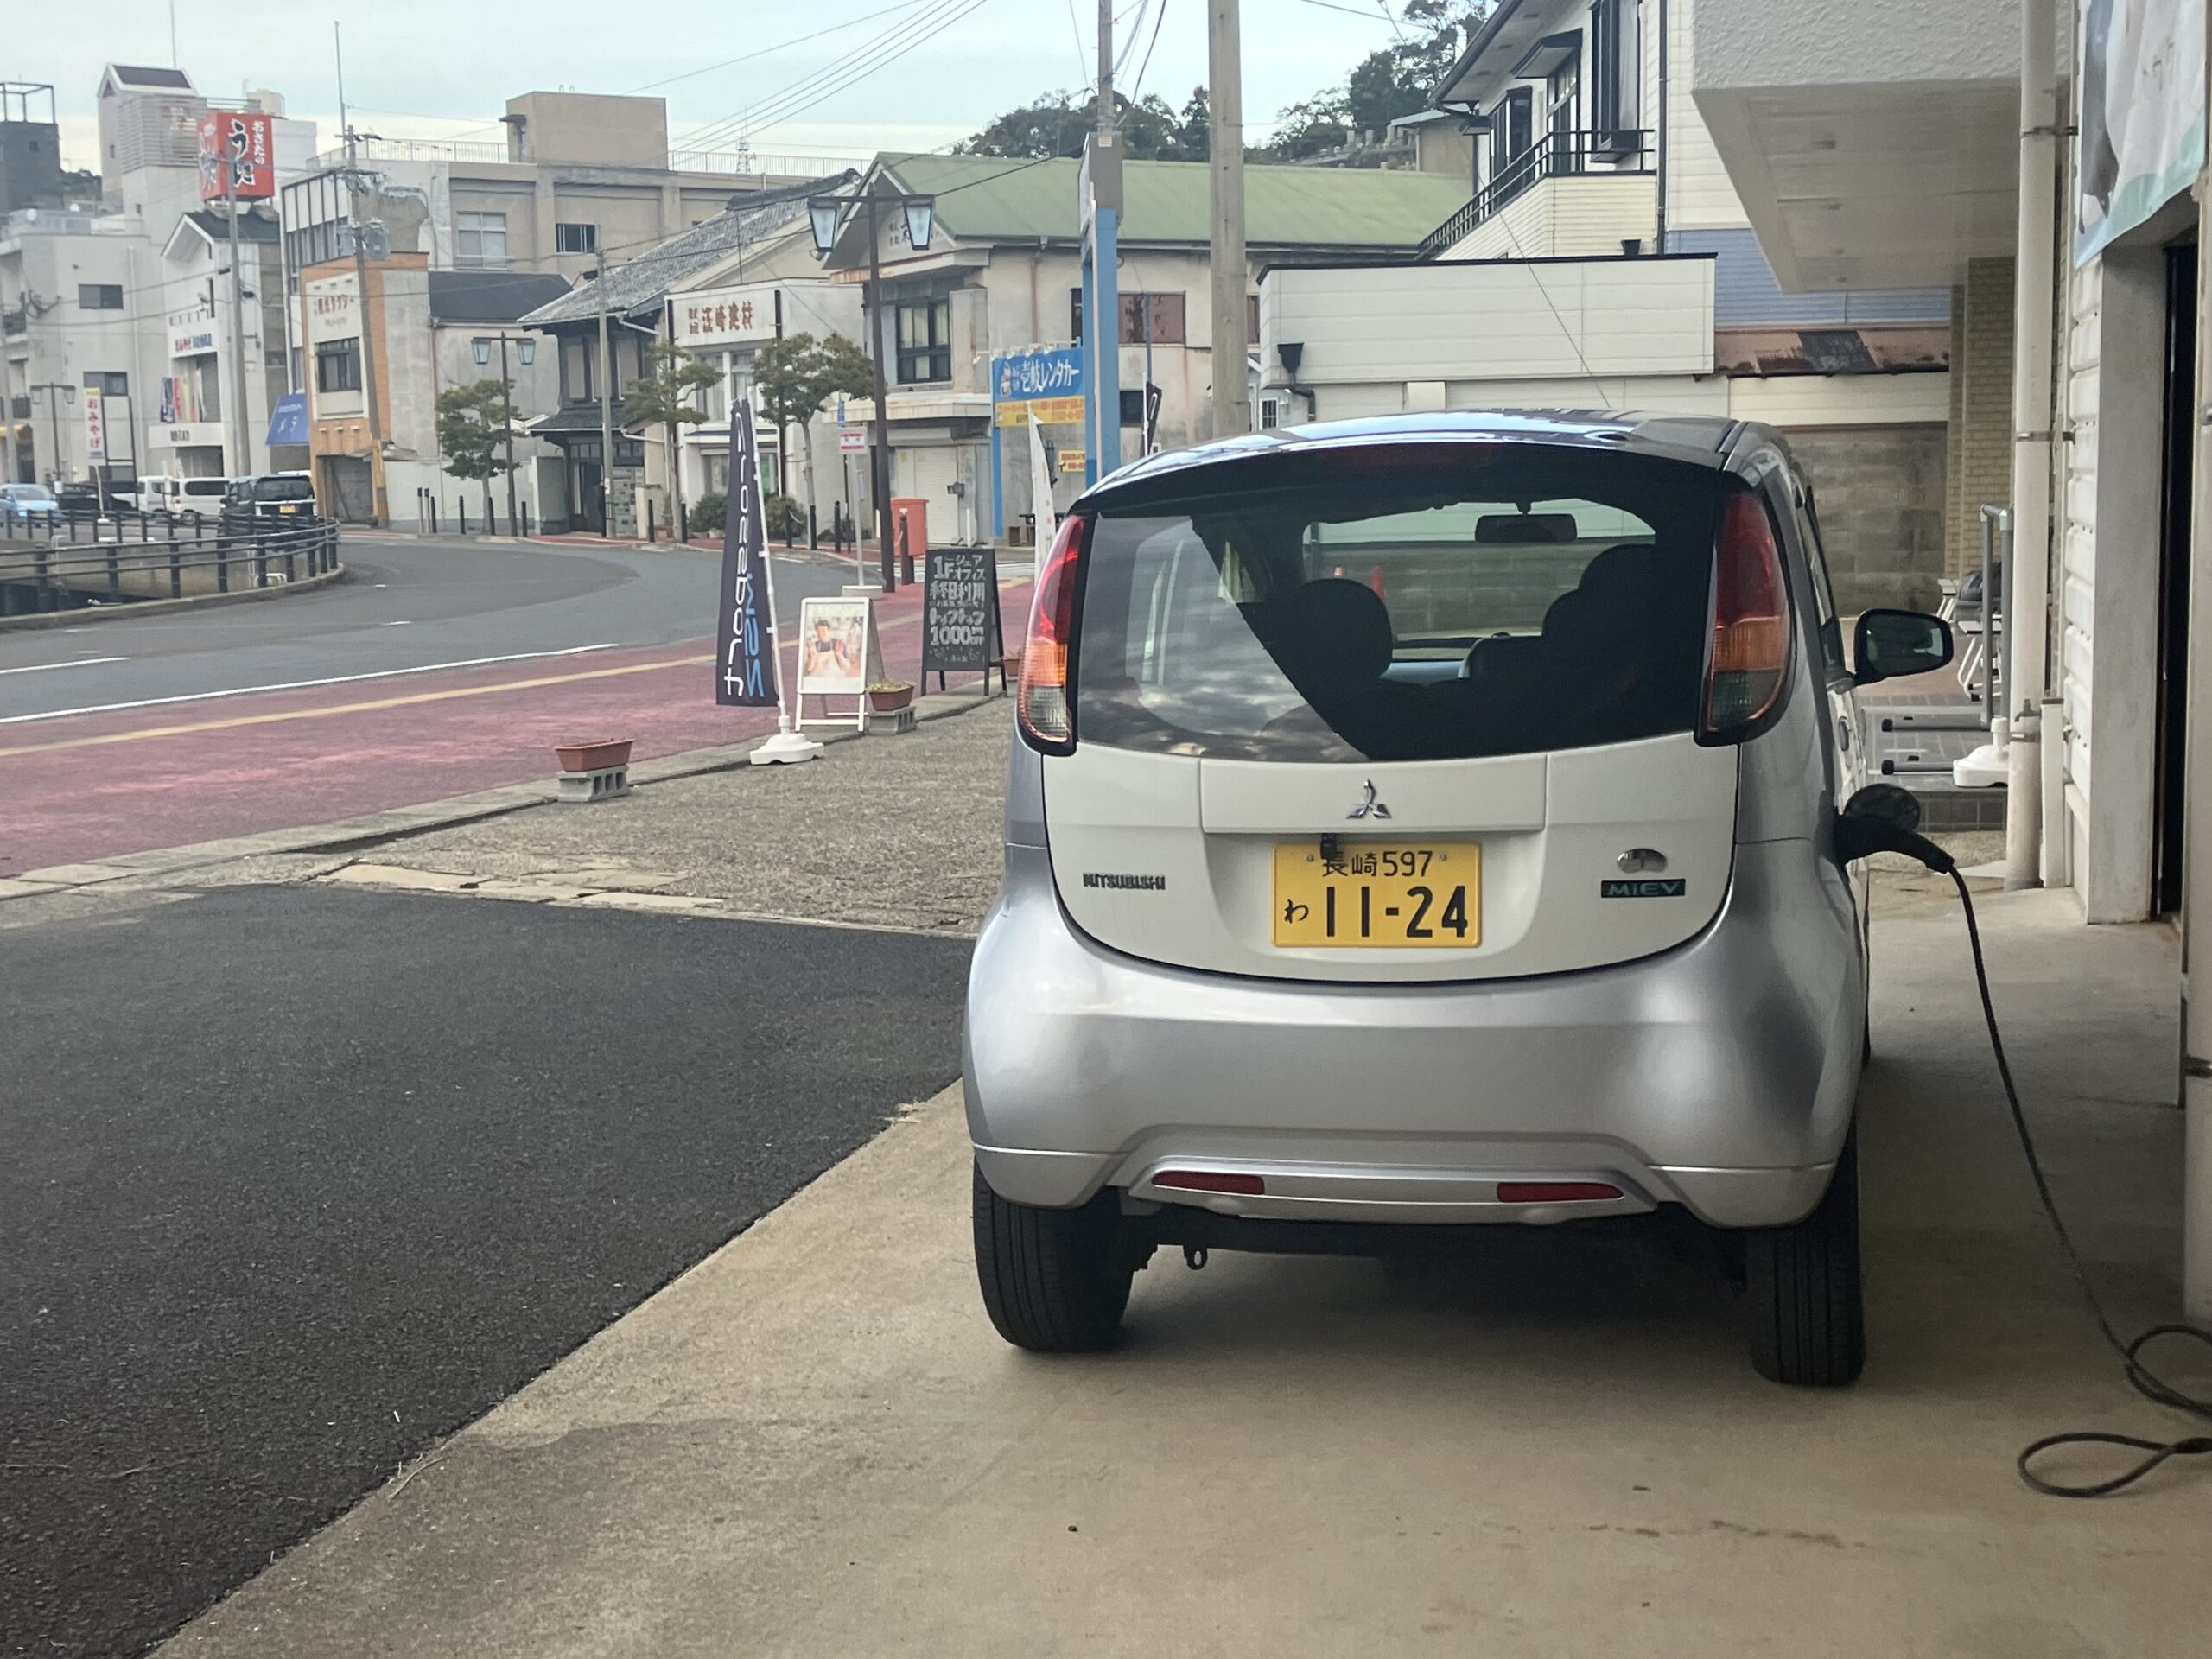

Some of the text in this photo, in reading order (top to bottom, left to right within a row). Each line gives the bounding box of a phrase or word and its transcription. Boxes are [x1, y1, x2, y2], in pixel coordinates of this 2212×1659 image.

[1020, 359, 1080, 393] 壱岐レンタカー
[87, 398, 101, 448] おみやげ
[1083, 873, 1166, 890] MITSUBISHI
[1326, 885, 1468, 938] 11-24
